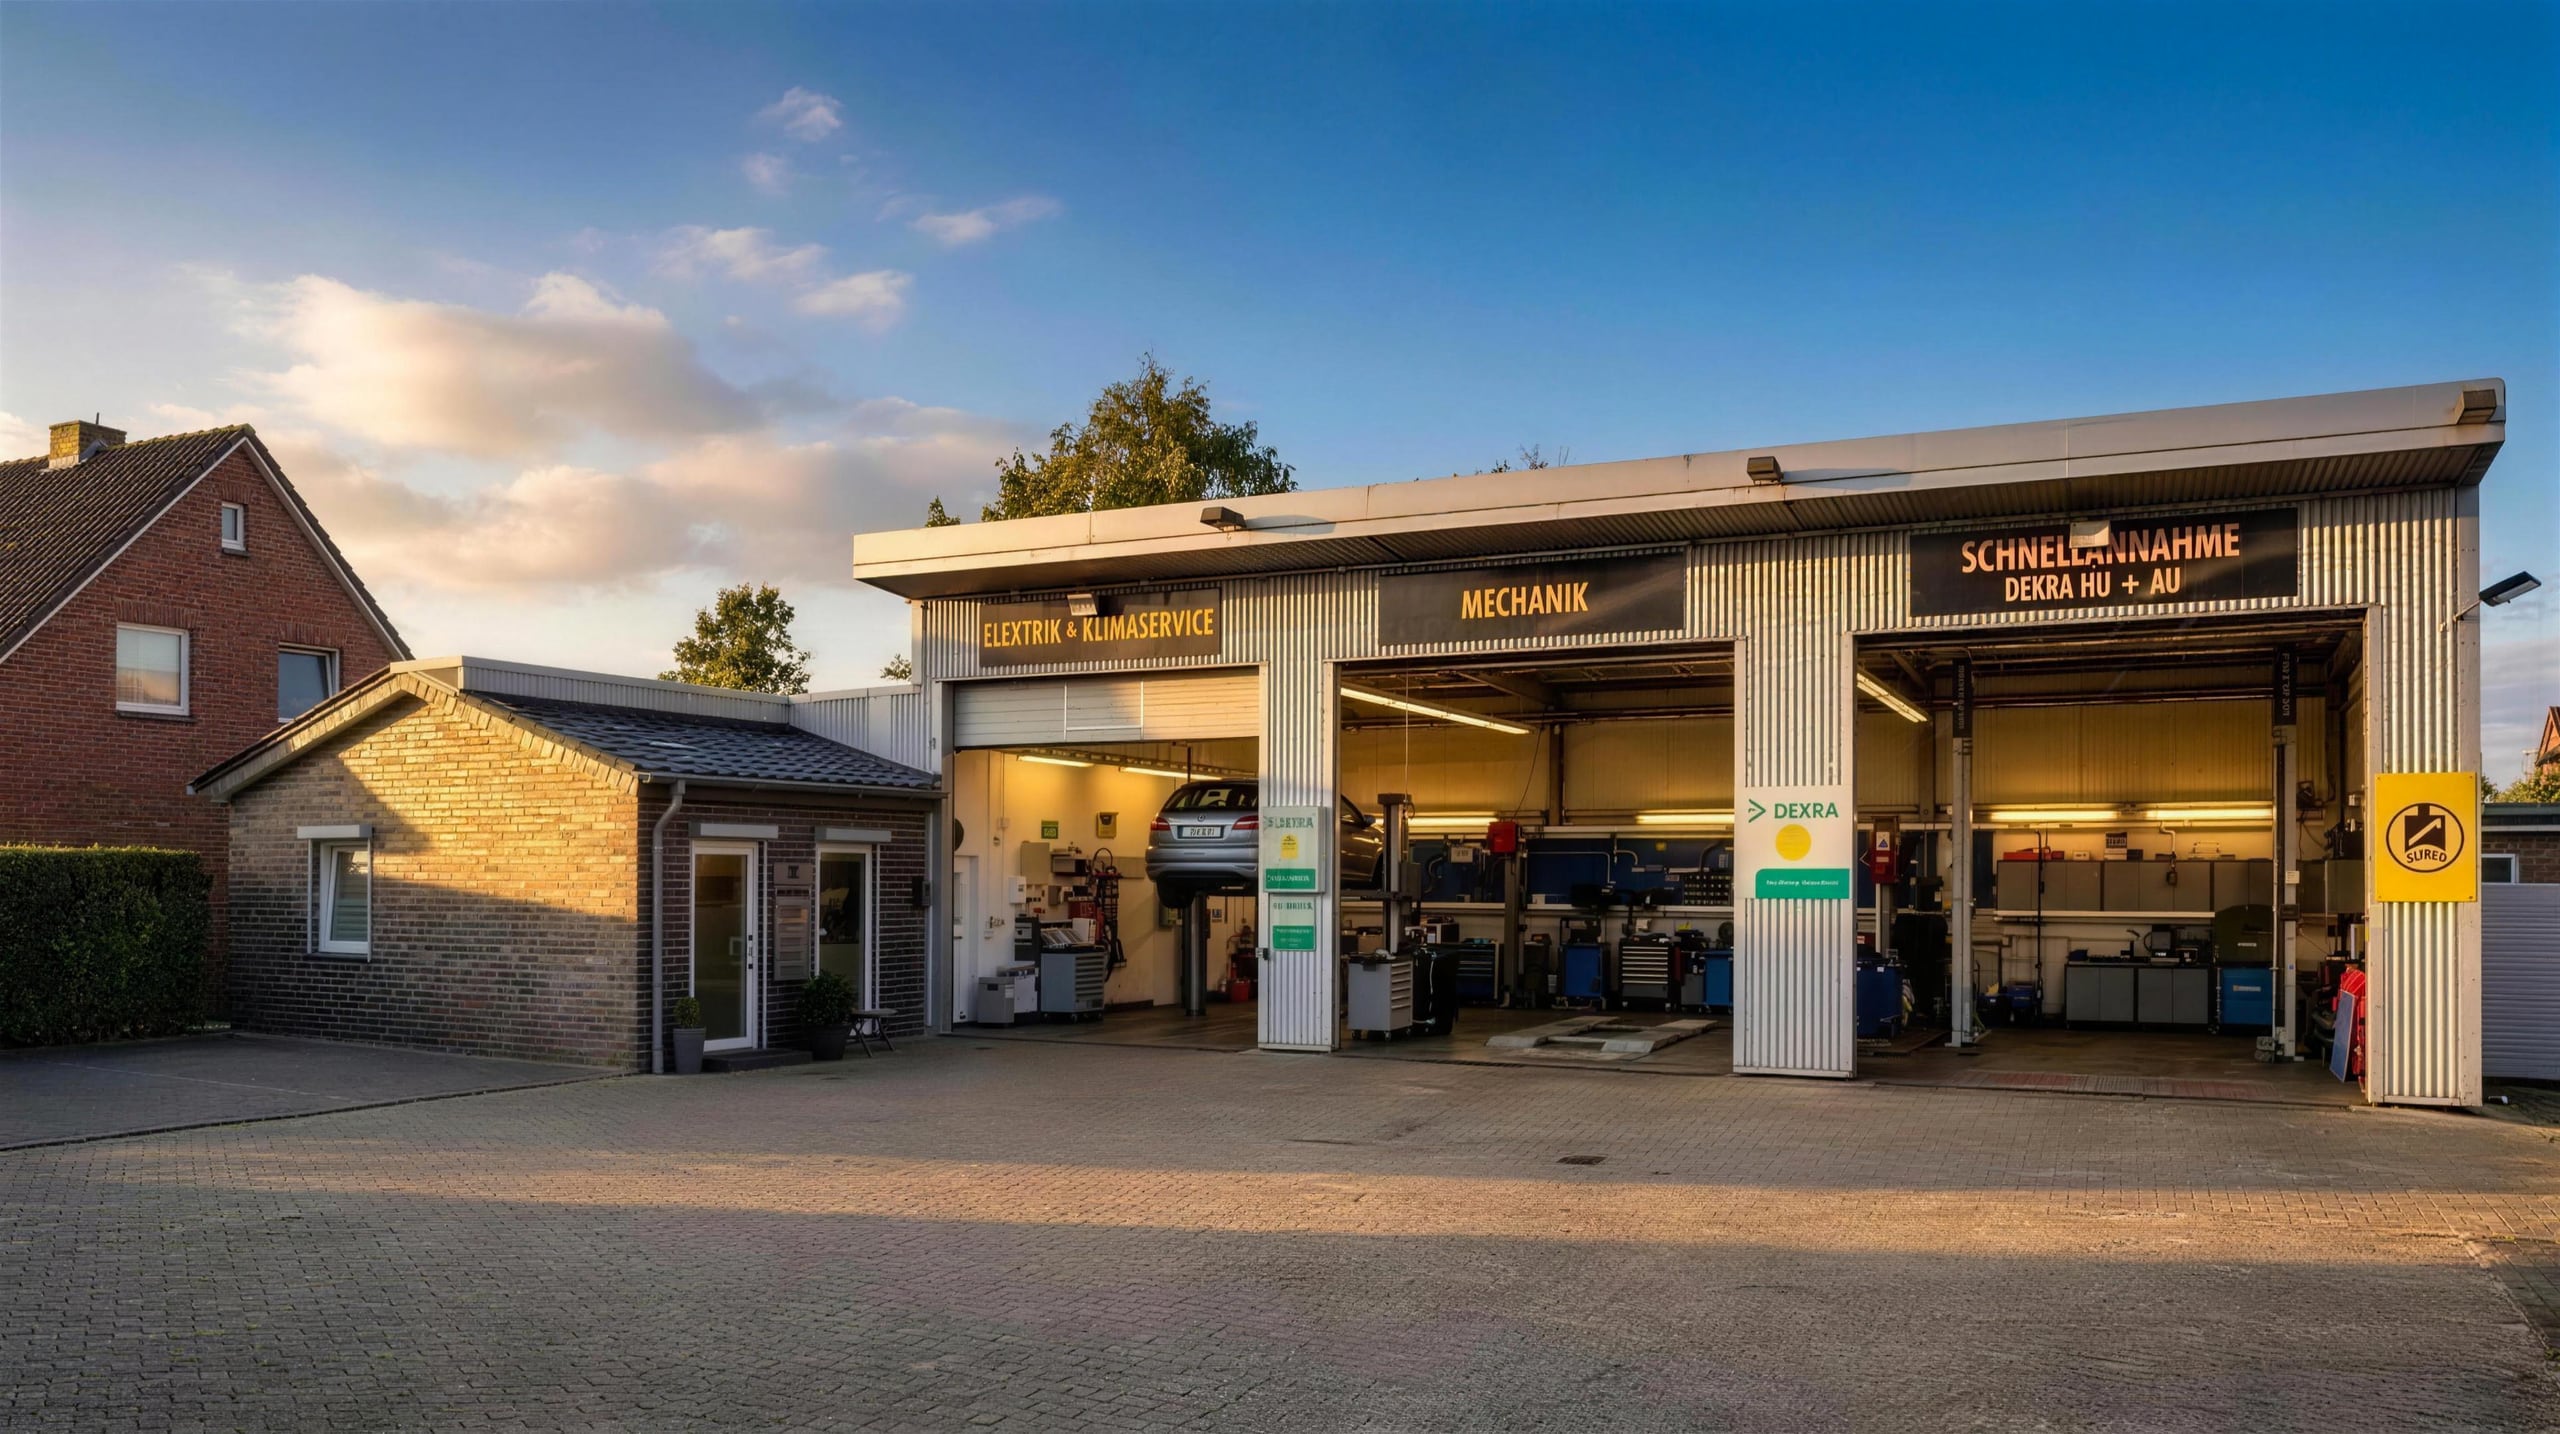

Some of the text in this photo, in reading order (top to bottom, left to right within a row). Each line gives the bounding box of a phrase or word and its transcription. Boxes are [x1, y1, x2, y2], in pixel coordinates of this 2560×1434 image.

[1961, 523, 2240, 573] SCHNELLANNAHME
[1461, 581, 1589, 620] MECHANIK
[2005, 567, 2181, 602] DEKRA HU + AU
[983, 608, 1214, 648] ELEXTRIK & KLIMASERVICE
[1774, 802, 1839, 819] DEXRA
